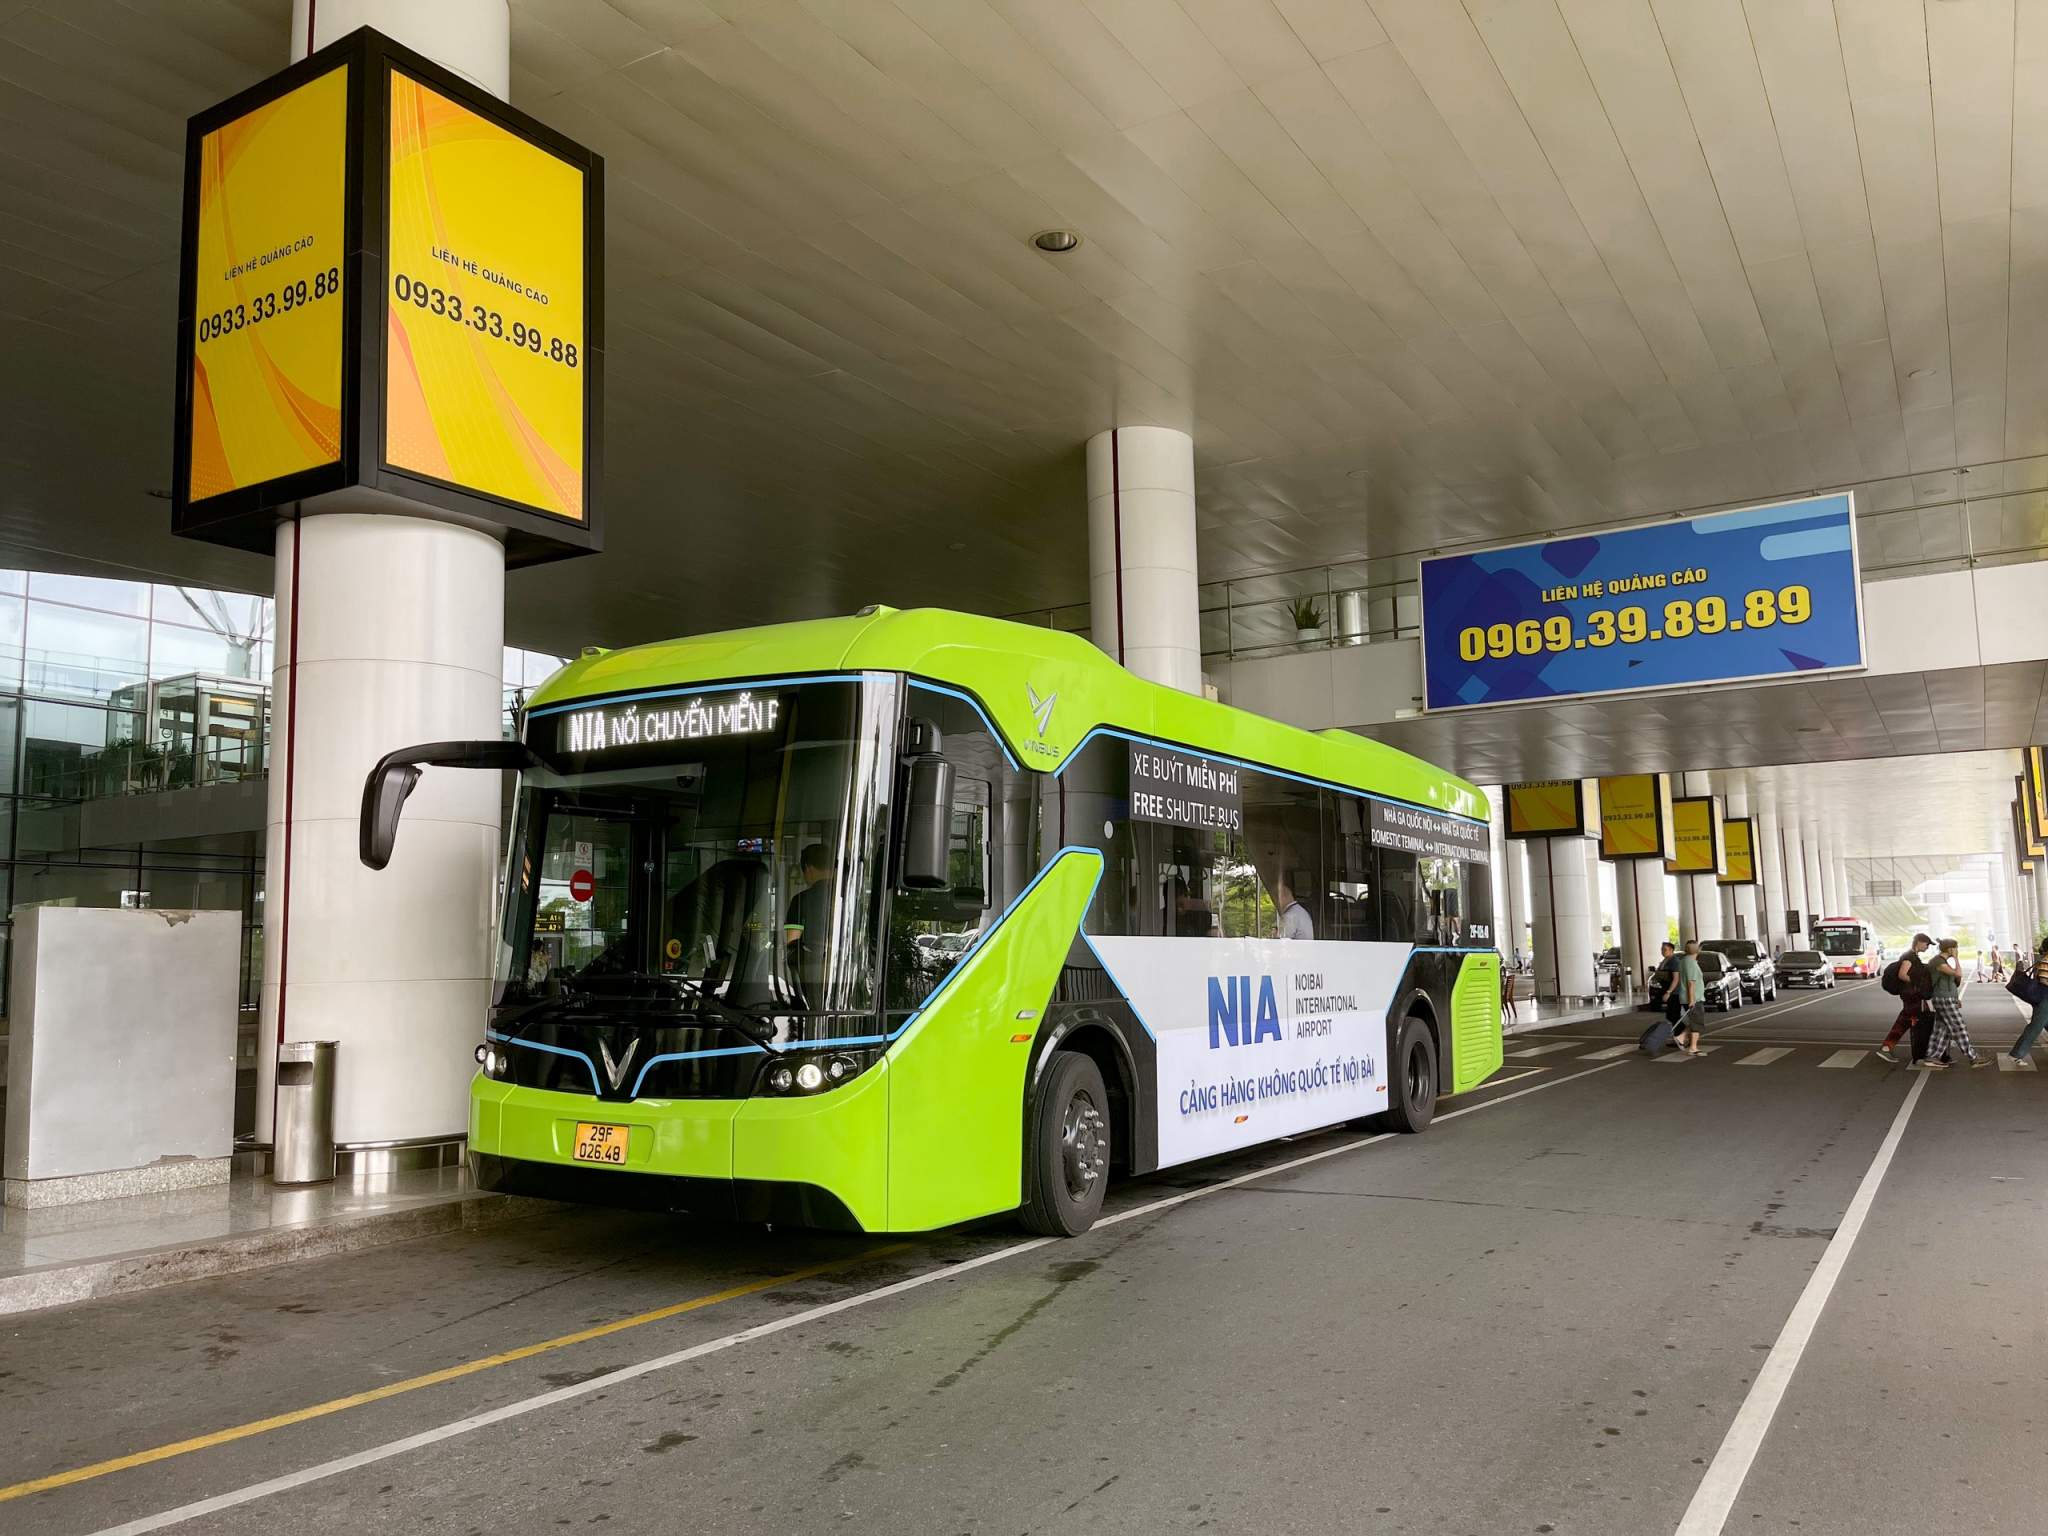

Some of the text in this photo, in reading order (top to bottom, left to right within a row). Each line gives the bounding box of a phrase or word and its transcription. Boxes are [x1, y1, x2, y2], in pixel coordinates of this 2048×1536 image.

[432, 246, 459, 267] LIÊN
[199, 267, 339, 343] 0933.33.99.88
[395, 273, 578, 368] 0933.33.99.88
[1541, 567, 1707, 603] LIÊN HỆ QUẢNG CÁO
[1459, 584, 1812, 662] 0969.39.89.89
[571, 711, 606, 752] NIA
[612, 705, 640, 745] NỐI
[644, 698, 713, 742] CHUYẾN
[718, 692, 762, 734] MIỄN
[1134, 752, 1238, 795] XE BUÝT MIỄN PHÍ
[1133, 791, 1239, 830] FREE SHUTTLE BUS
[1371, 828, 1402, 847] DOMESTIC
[1295, 973, 1323, 991] NOIBAI
[1207, 975, 1282, 1049] NIA
[1295, 995, 1358, 1015] INTERNATIONAL
[1297, 1018, 1332, 1039] AIRPORT
[1180, 1054, 1374, 1115] CẢNG HÀNG KHÔNG QUỐC TẾ NỘI BÀI
[580, 1143, 620, 1161] 026.48
[590, 1126, 613, 1142] 29F
